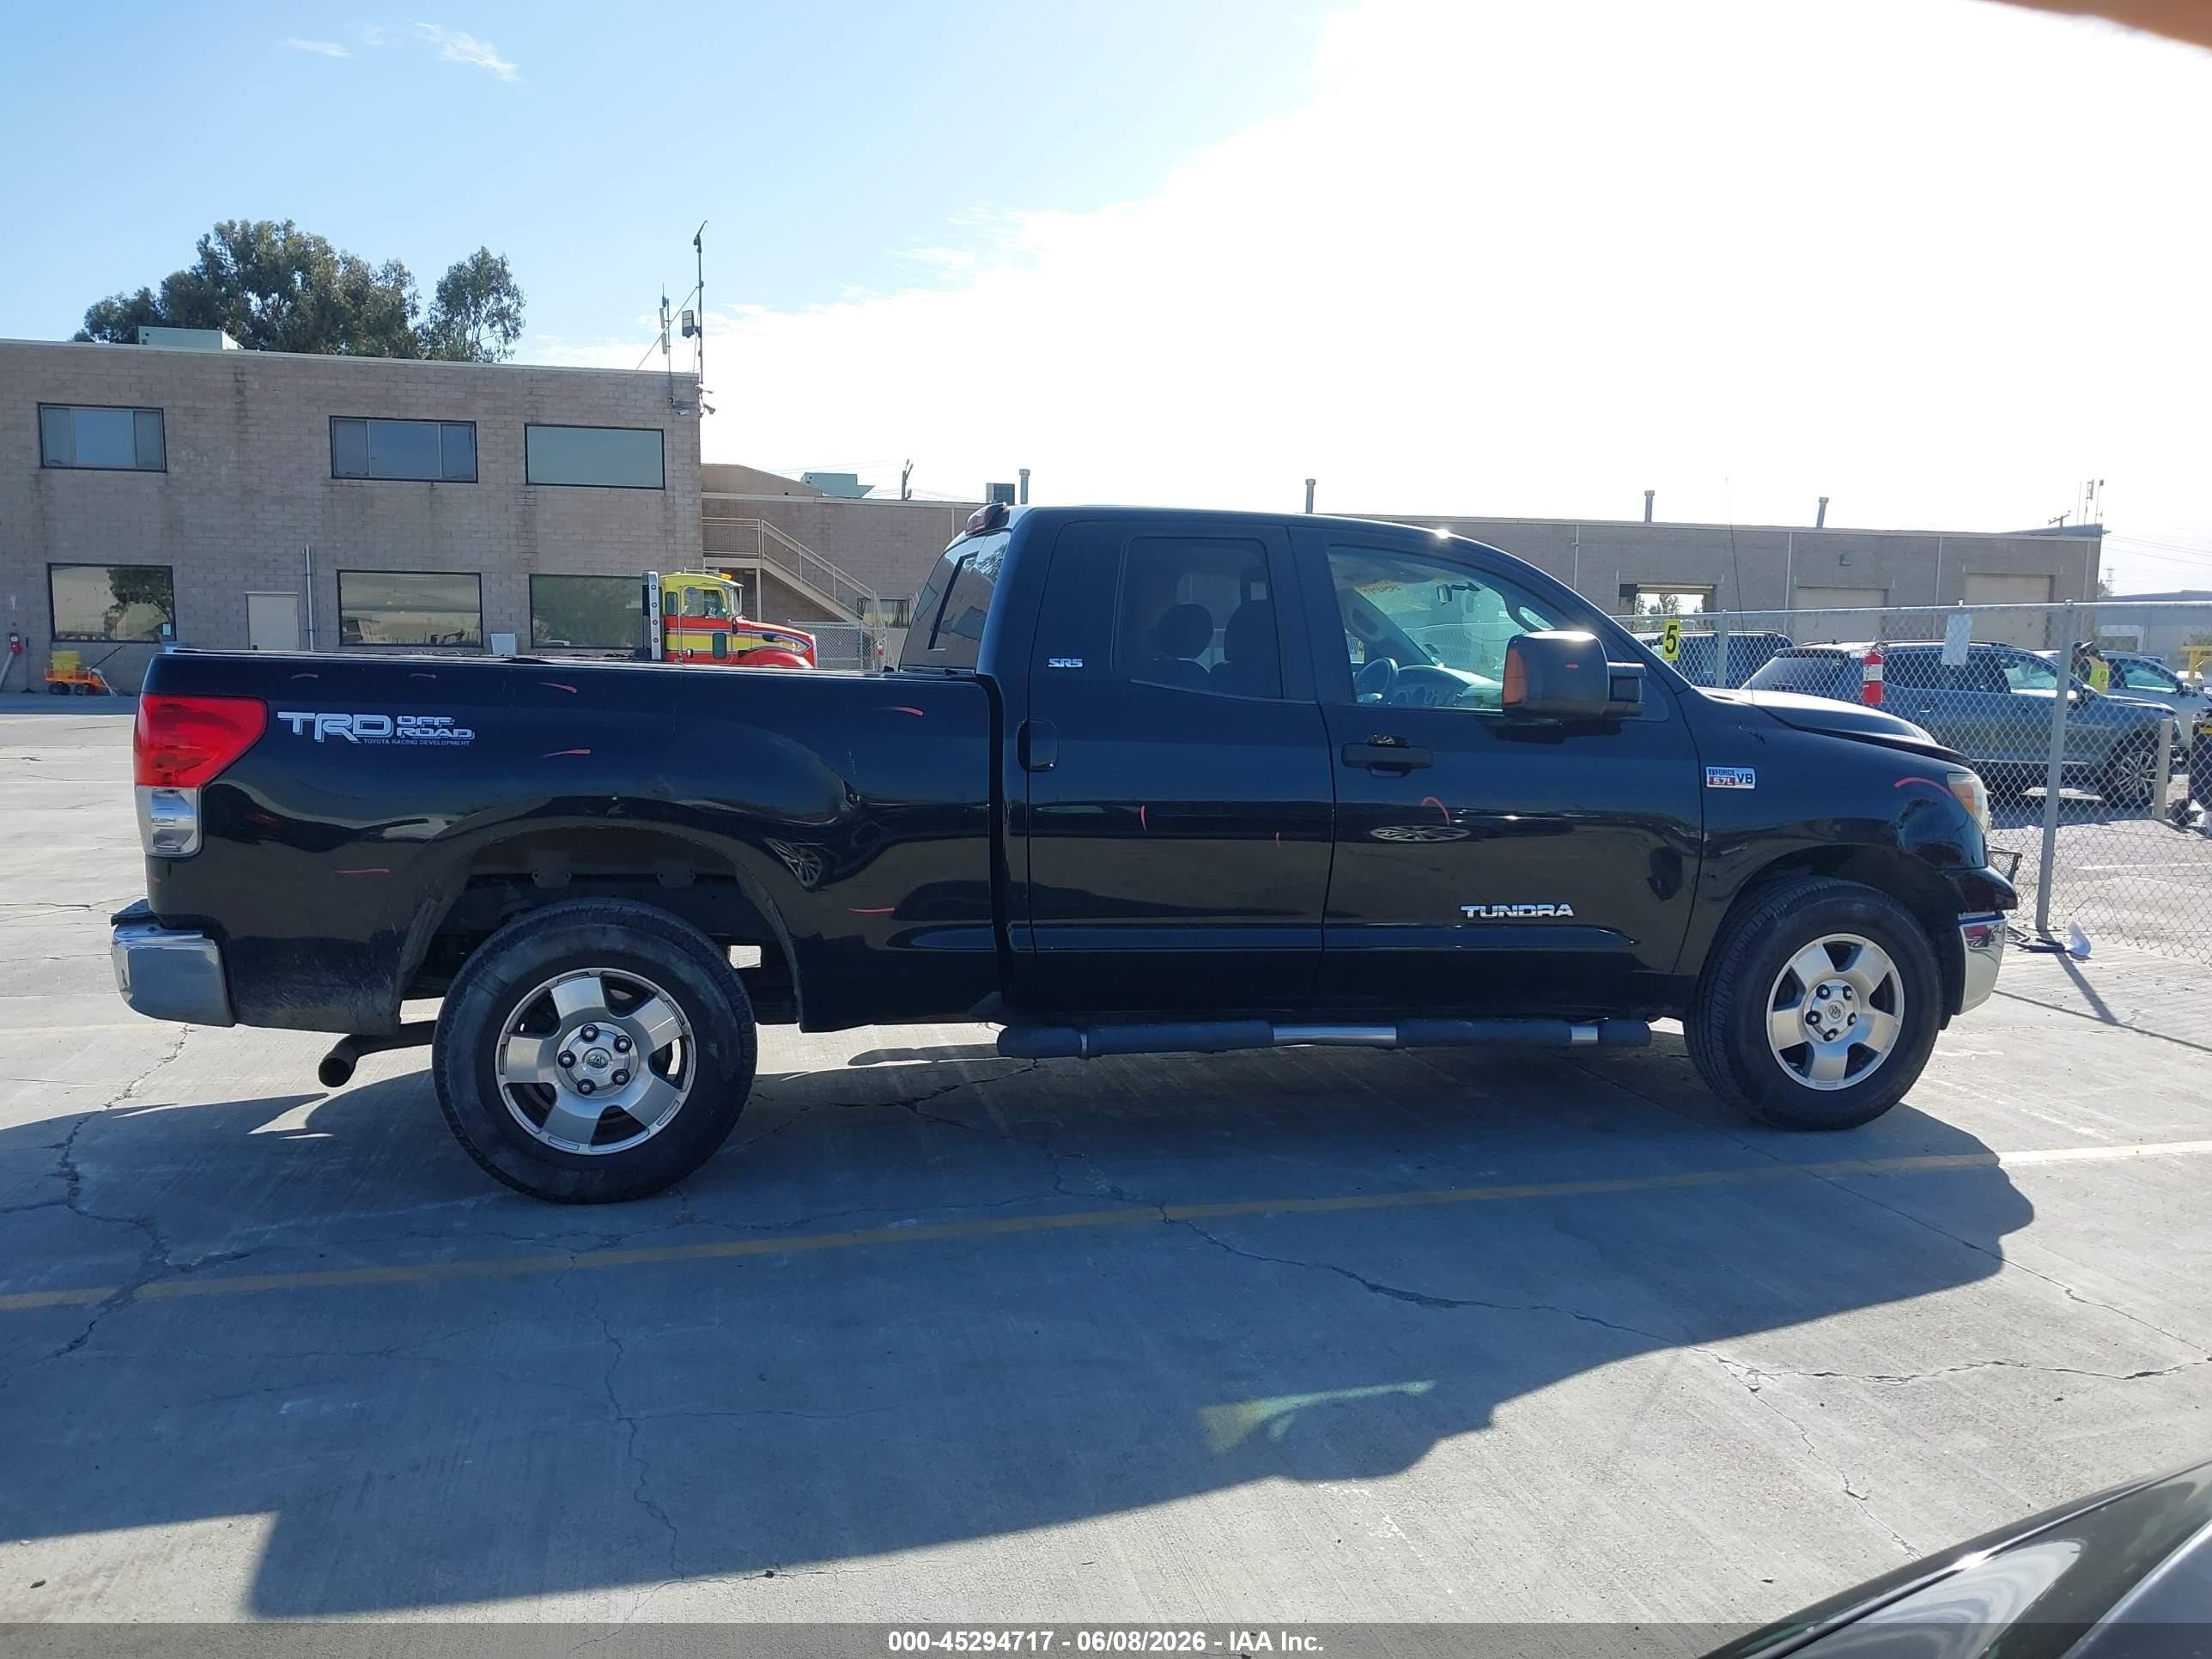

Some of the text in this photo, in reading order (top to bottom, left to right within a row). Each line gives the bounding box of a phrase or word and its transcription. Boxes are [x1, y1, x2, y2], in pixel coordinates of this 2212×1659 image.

[1665, 624, 1678, 654] 5
[1048, 658, 1083, 667] SR5
[277, 712, 394, 744] TRD
[397, 715, 454, 728] OFF
[396, 727, 475, 739] ROAD
[1736, 773, 1753, 784] V8
[1461, 903, 1574, 919] TUNDRA
